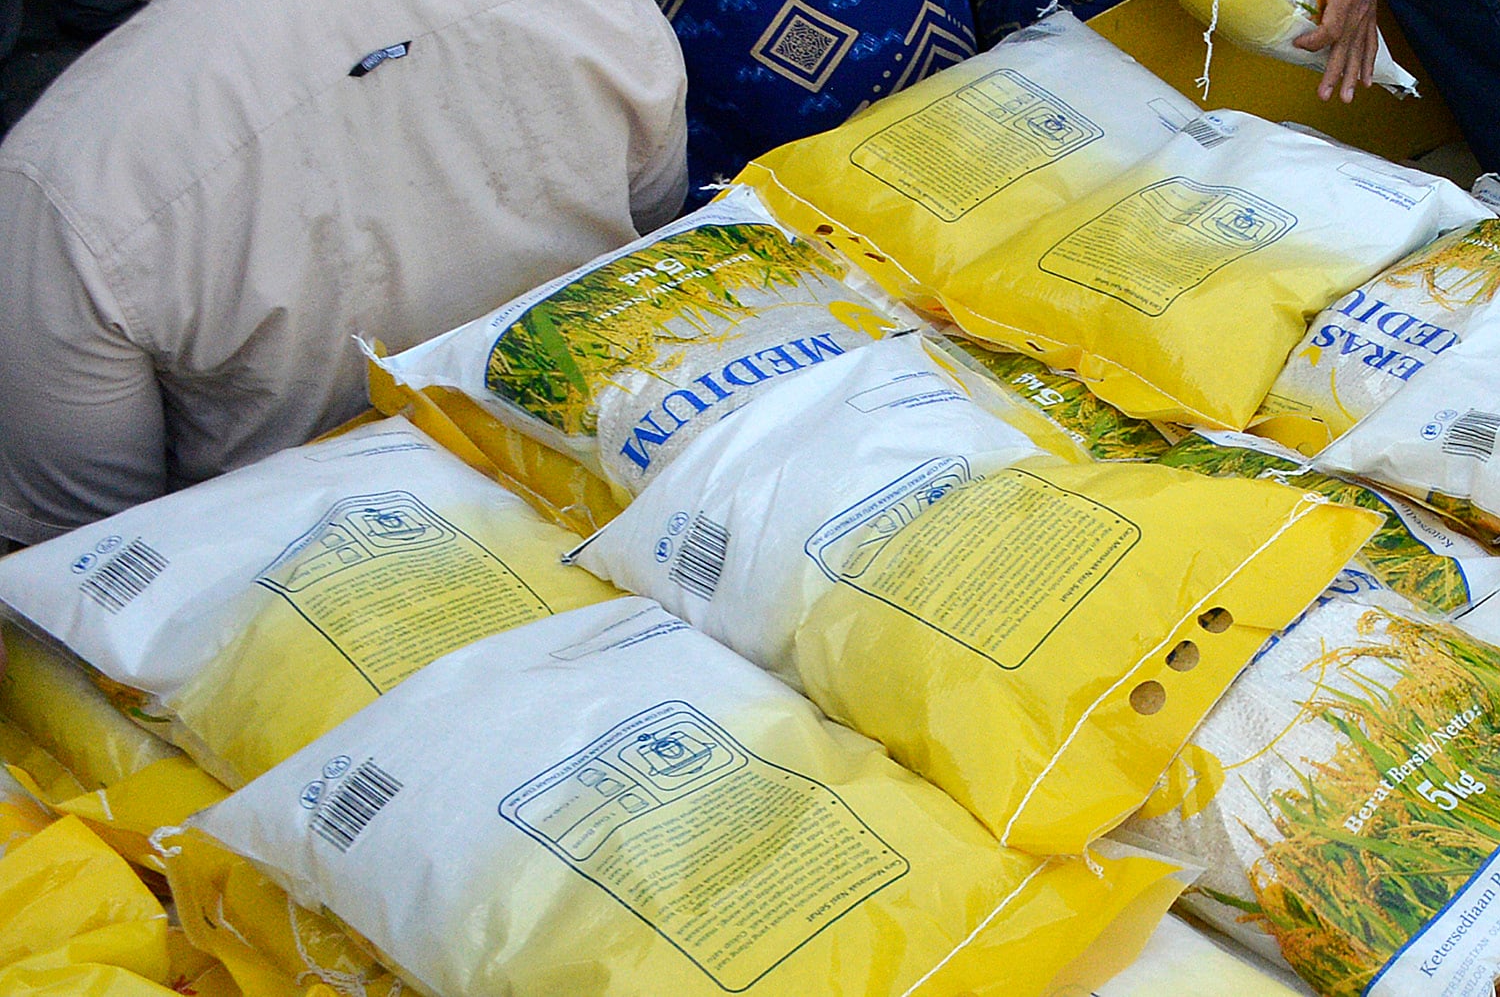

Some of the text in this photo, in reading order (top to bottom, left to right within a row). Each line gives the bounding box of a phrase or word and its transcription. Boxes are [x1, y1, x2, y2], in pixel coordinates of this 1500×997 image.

[1309, 320, 1425, 385] ERAS
[1326, 281, 1459, 359] EDIU
[619, 332, 843, 472] MEDIUM
[1059, 526, 1134, 603] Cara Memasak Nasi Sehat
[1342, 698, 1484, 837] Berat Bersih/Netto:
[804, 901, 831, 924] Sehat
[828, 889, 849, 906] Nasi
[847, 867, 885, 893] Memasak
[1418, 885, 1497, 979] Ketersediaan
[1441, 935, 1491, 997] TRIBUSIKAN
